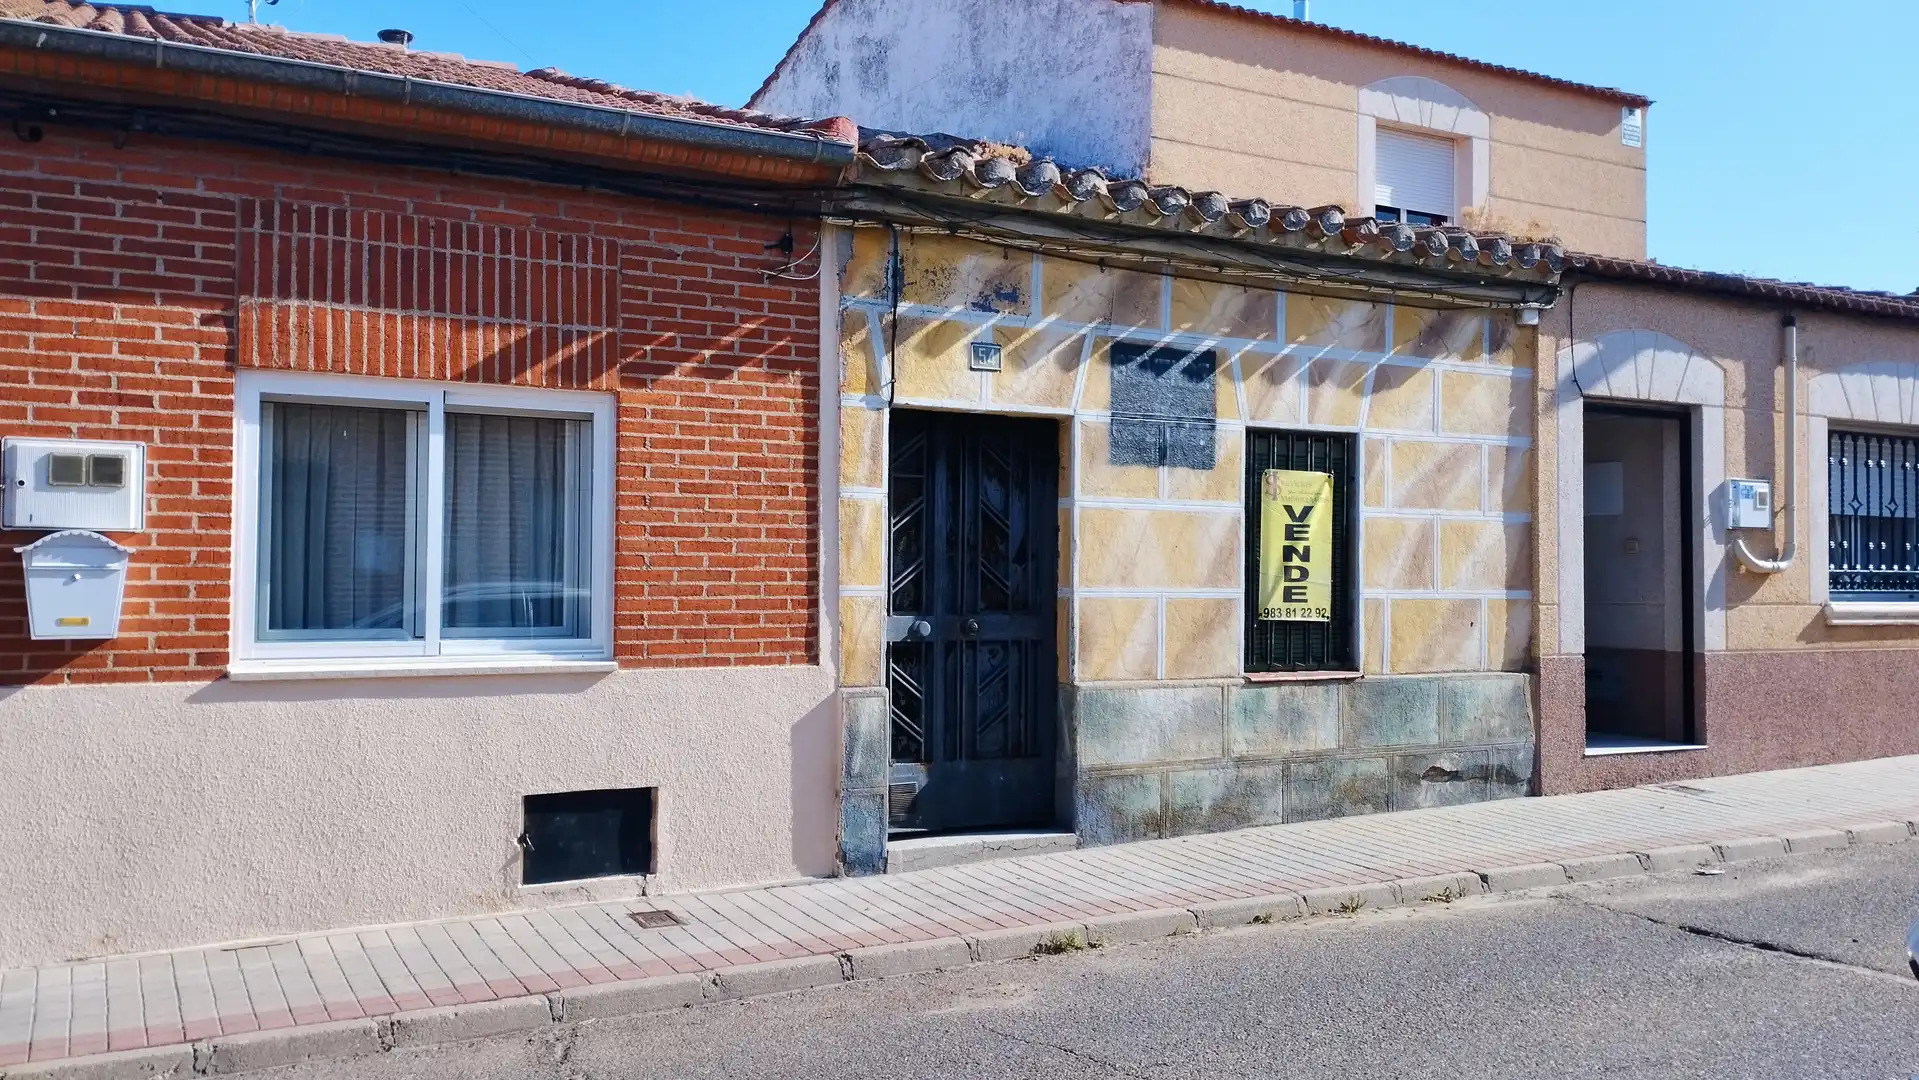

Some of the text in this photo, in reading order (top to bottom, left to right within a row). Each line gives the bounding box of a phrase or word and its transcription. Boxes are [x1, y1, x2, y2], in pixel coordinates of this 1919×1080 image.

[978, 348, 995, 366] 54
[1282, 505, 1314, 603] VENDE
[1263, 607, 1327, 619] 983 81 22 92
